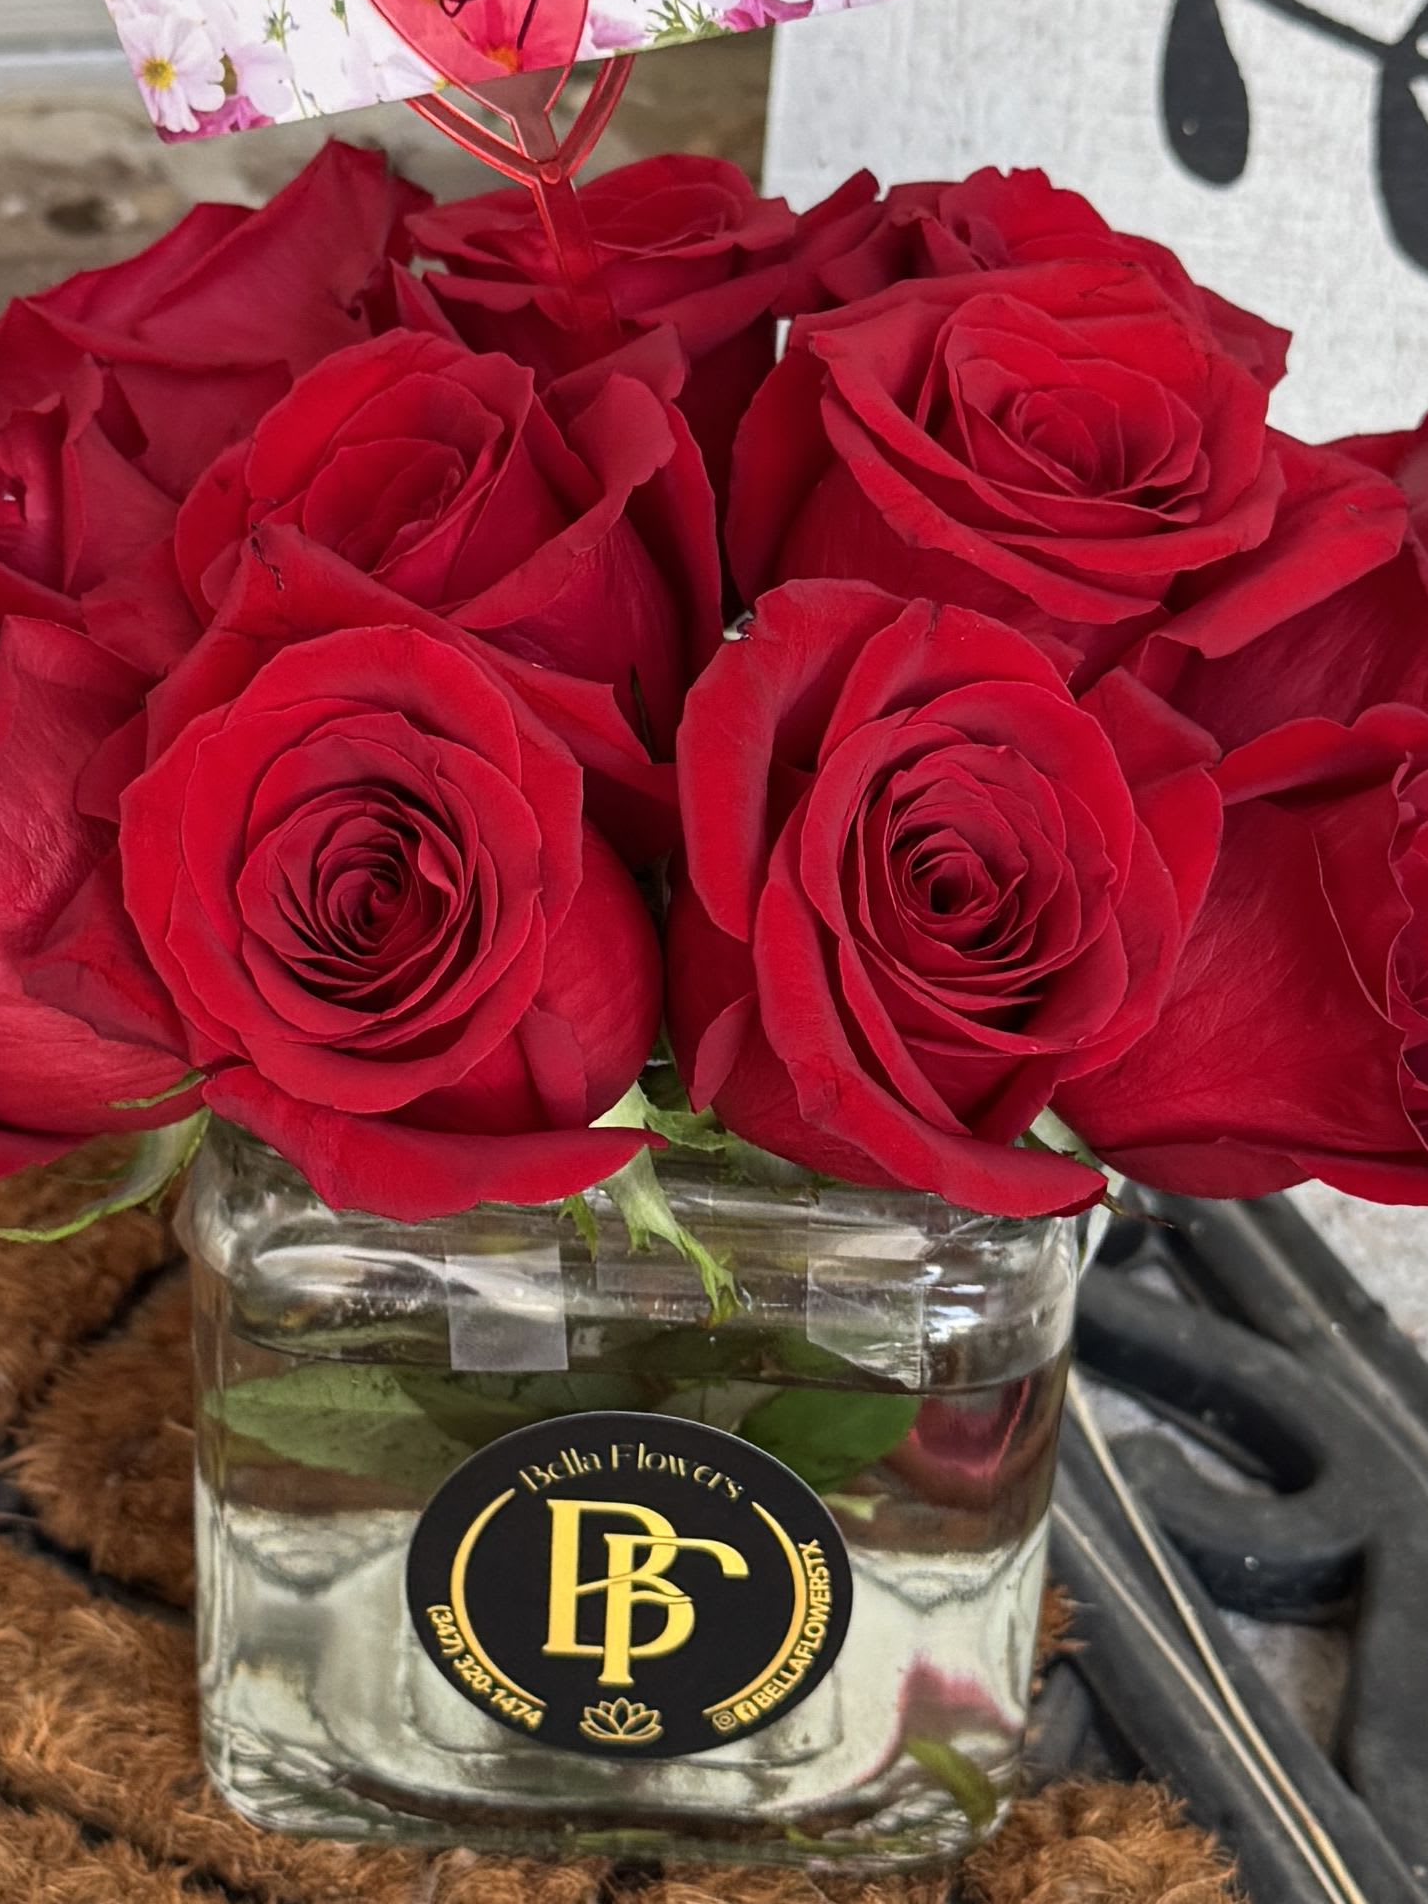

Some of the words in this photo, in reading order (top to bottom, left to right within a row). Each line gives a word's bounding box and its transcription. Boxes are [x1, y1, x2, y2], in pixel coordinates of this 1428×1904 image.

[518, 1446, 603, 1492] Bella
[610, 1441, 745, 1500] Flowers
[425, 1603, 466, 1658] (347)
[452, 1653, 544, 1731] 320-1474
[751, 1538, 832, 1711] BELLAFLOWERSTX
